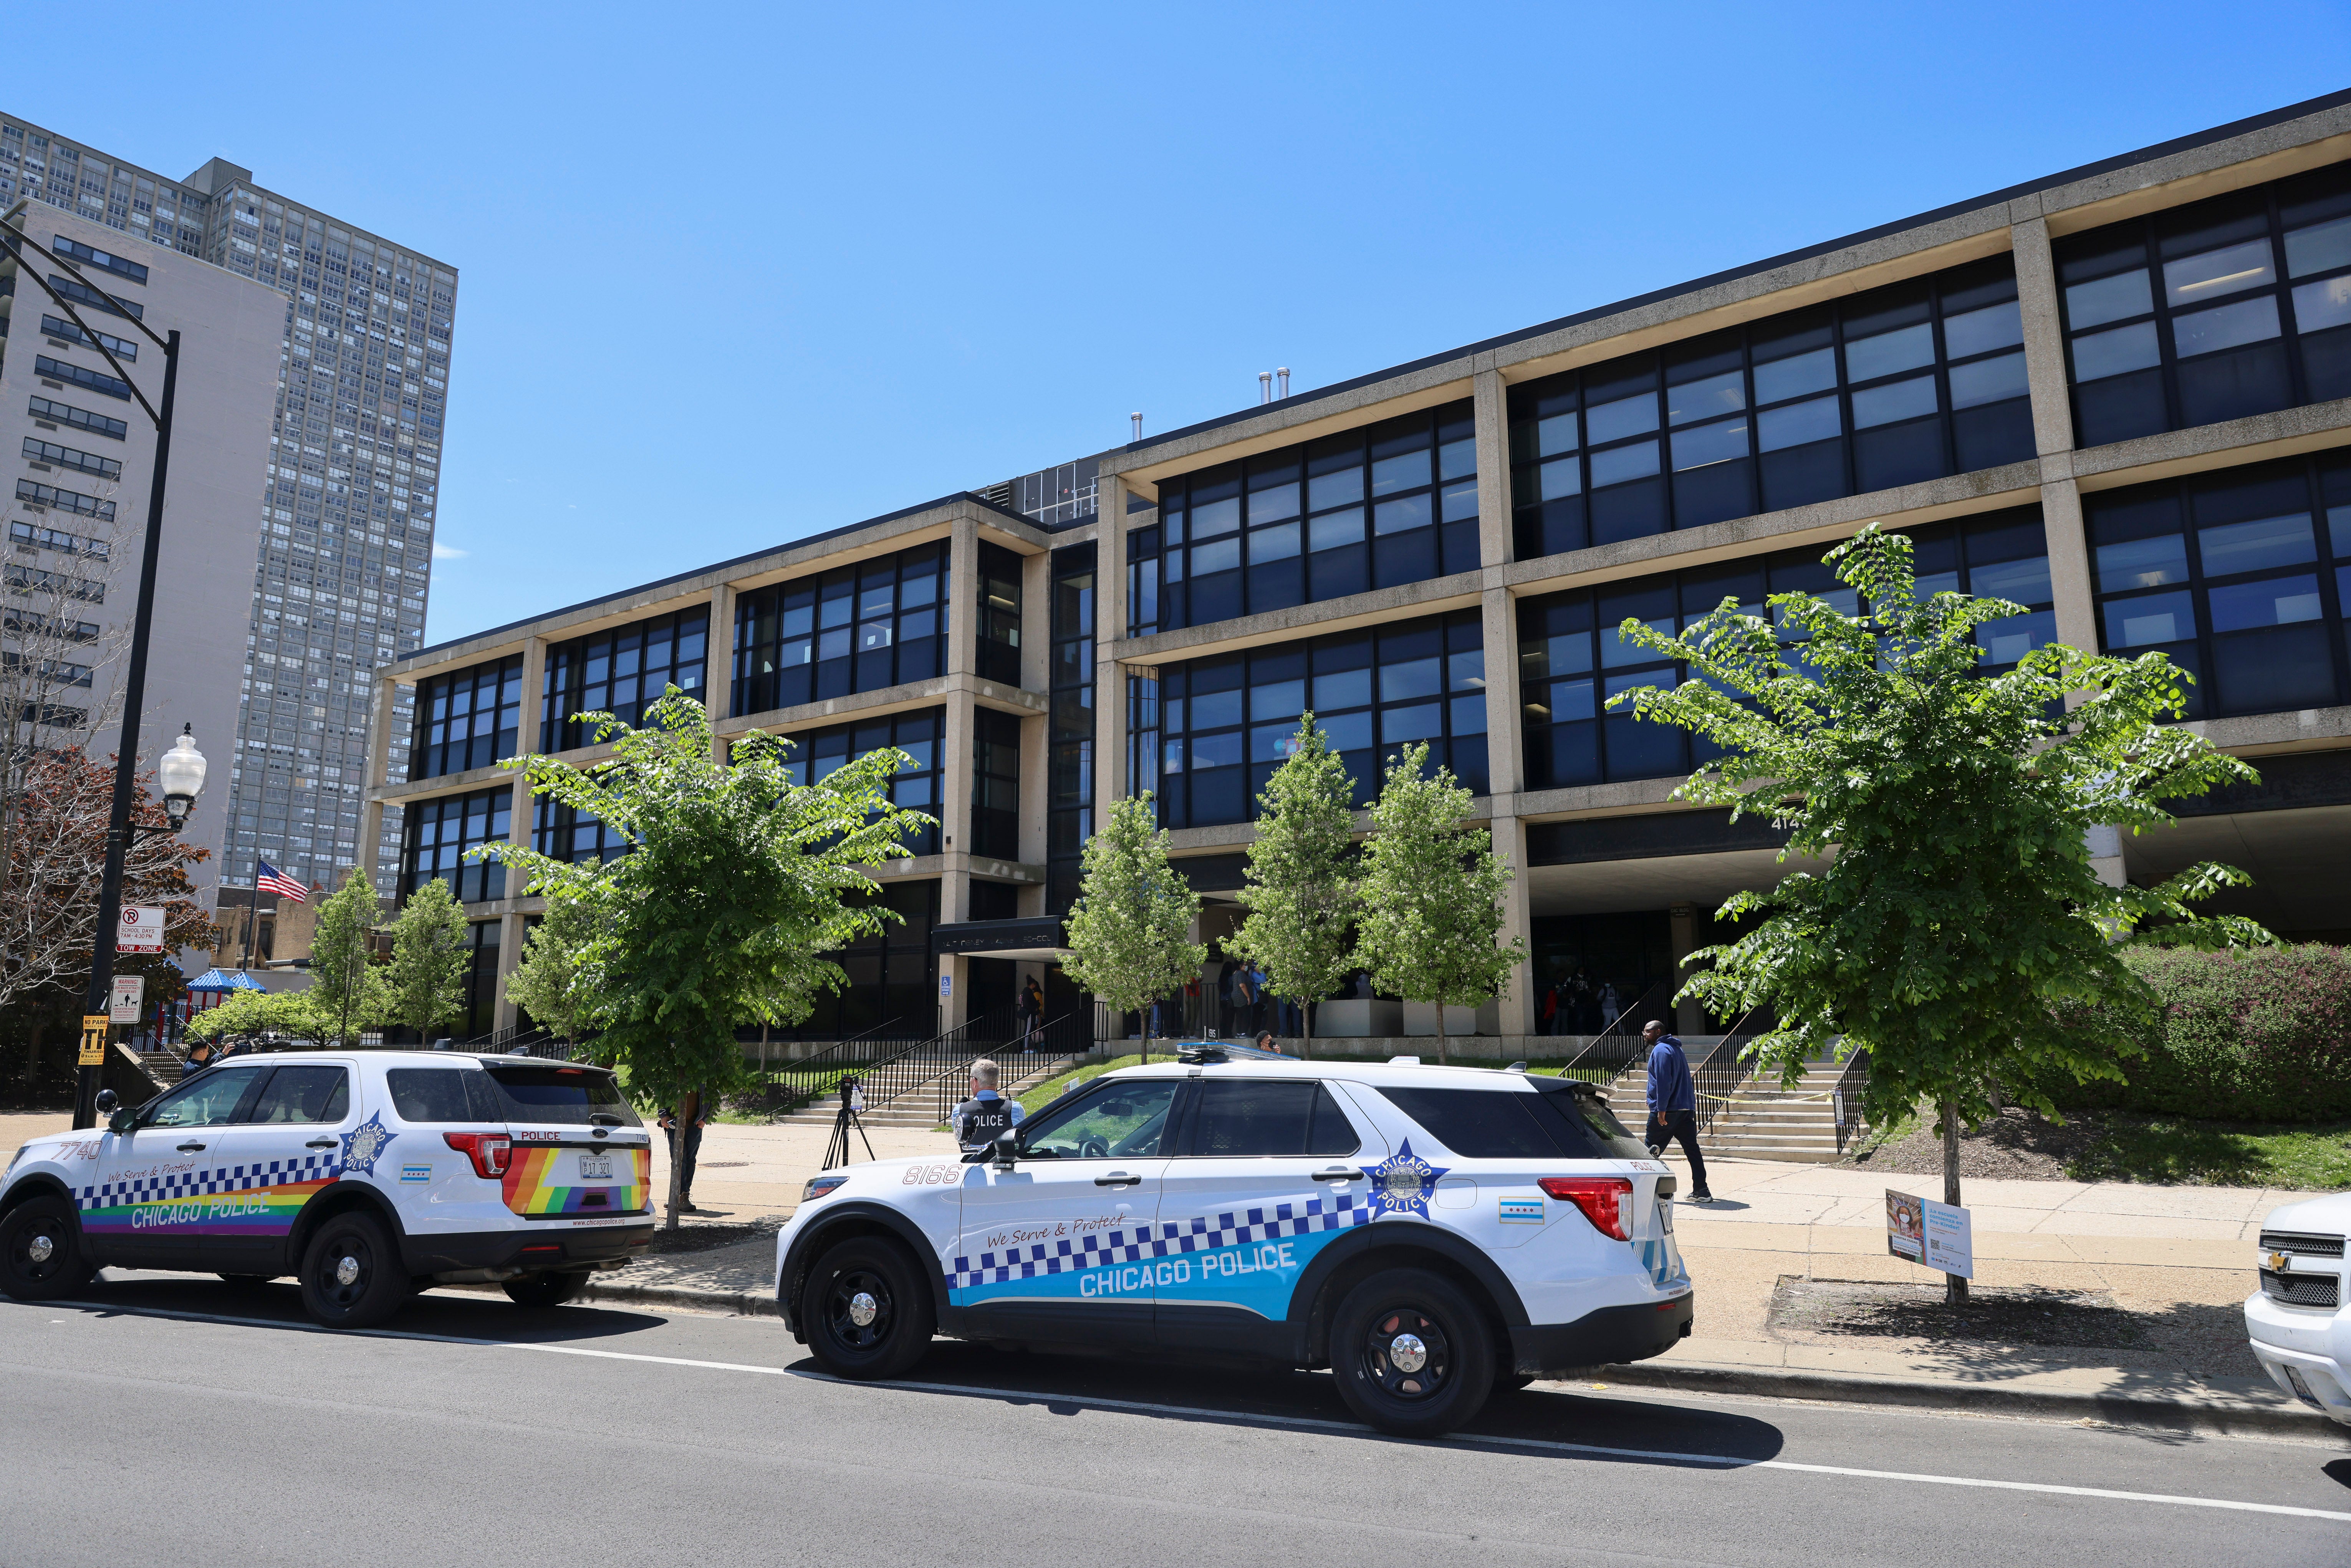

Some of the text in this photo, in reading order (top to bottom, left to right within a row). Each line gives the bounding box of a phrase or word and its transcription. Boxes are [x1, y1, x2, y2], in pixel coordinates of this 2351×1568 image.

[974, 1115, 1003, 1127] OLICE
[349, 1123, 385, 1143] CHICAGO
[522, 1132, 561, 1140] POLICE
[636, 1134, 646, 1142] 7740
[51, 1141, 103, 1160] 7740
[343, 1153, 377, 1170] POLICE
[589, 1163, 595, 1174] 17
[599, 1163, 609, 1174] 327
[1375, 1155, 1432, 1177] CHICAGO
[1630, 1162, 1656, 1171] POLICE
[108, 1161, 196, 1183] We Serve & Protect
[902, 1164, 963, 1184] 8166
[132, 1192, 271, 1229] CHICAGO POLICE
[1377, 1192, 1429, 1212] POLICE
[1929, 1214, 1955, 1224] comienza
[1930, 1219, 1960, 1230] Pre-Kinder!
[988, 1212, 1126, 1248] We Serve & Protect
[1079, 1242, 1296, 1297] CHICAGO POLICE
